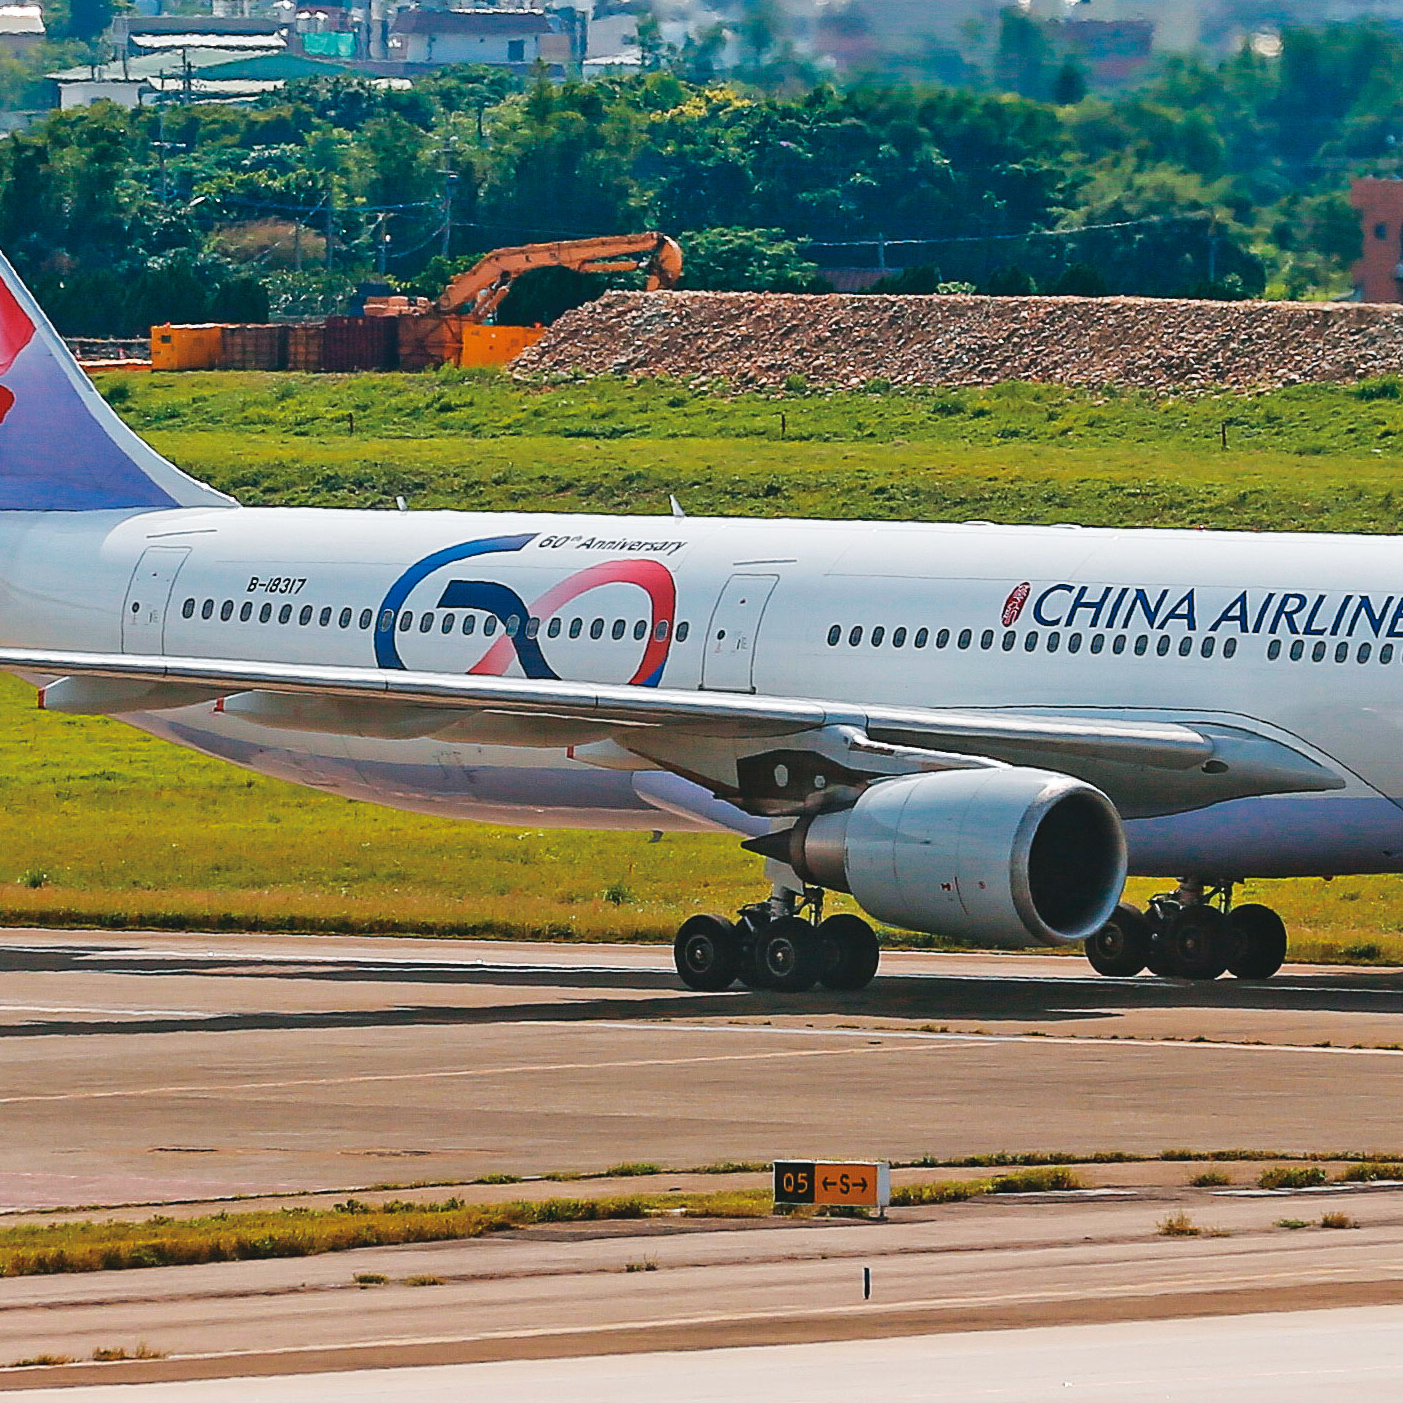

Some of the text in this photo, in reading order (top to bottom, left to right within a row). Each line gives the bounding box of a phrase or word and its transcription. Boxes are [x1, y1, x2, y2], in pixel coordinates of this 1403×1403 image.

[575, 536, 688, 557] Anniversary
[246, 576, 308, 595] B-18317
[1032, 582, 1198, 633] CHINA
[783, 1172, 851, 1195] Q5 S
